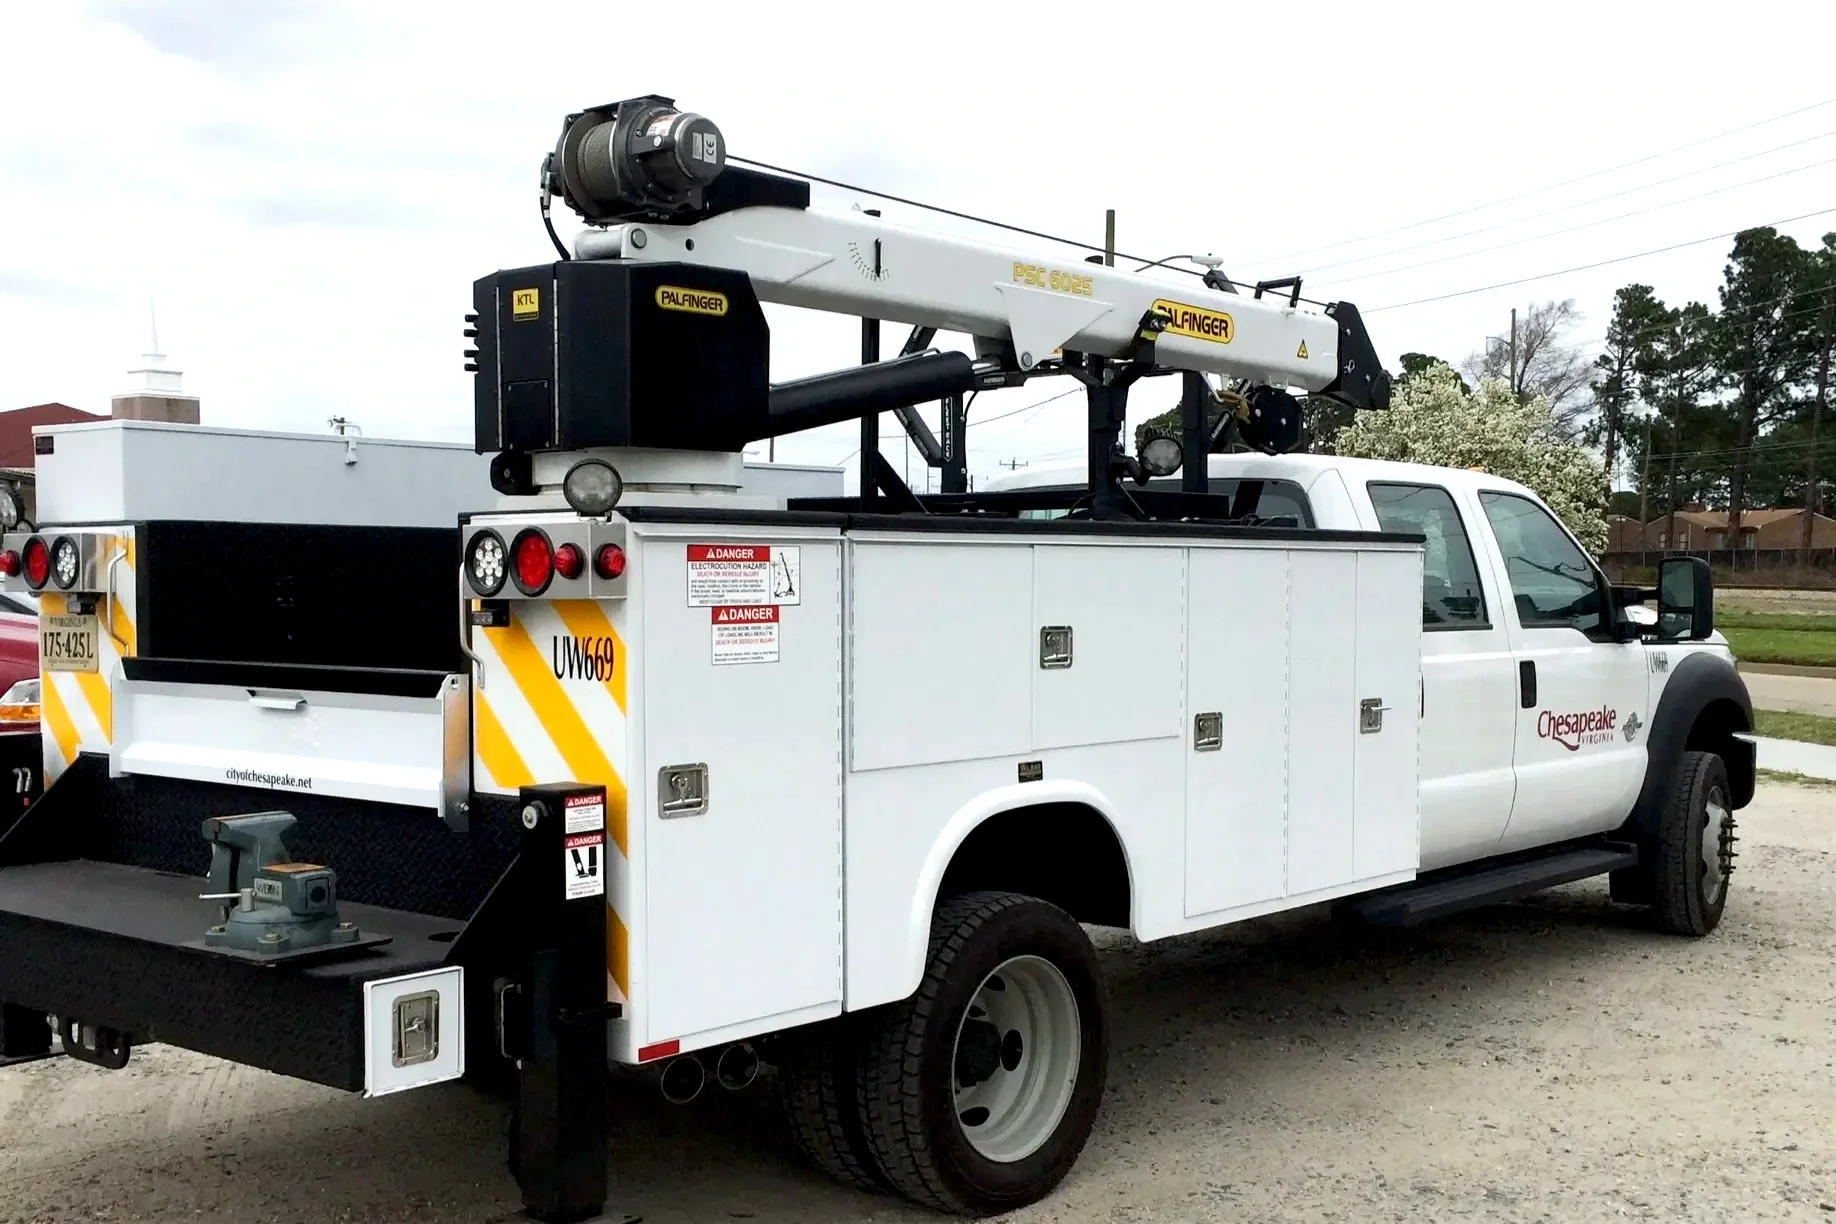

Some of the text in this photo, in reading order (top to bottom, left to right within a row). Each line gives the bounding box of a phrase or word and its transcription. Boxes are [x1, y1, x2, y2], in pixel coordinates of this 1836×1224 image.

[1013, 263, 1093, 296] PSC 6025
[517, 293, 535, 306] KTL
[661, 290, 723, 311] PALFINGER
[716, 548, 754, 559] DANGER
[691, 562, 768, 570] ELECTROCUTION HAZARD
[729, 607, 773, 620] DANGER
[553, 635, 614, 682] UW669
[1538, 705, 1616, 743] Chesapeake
[1581, 732, 1614, 745] VIRGINIA
[226, 767, 312, 788] cityofchesapeake.net
[574, 795, 602, 806] DANGER
[574, 835, 602, 846] DANGER
